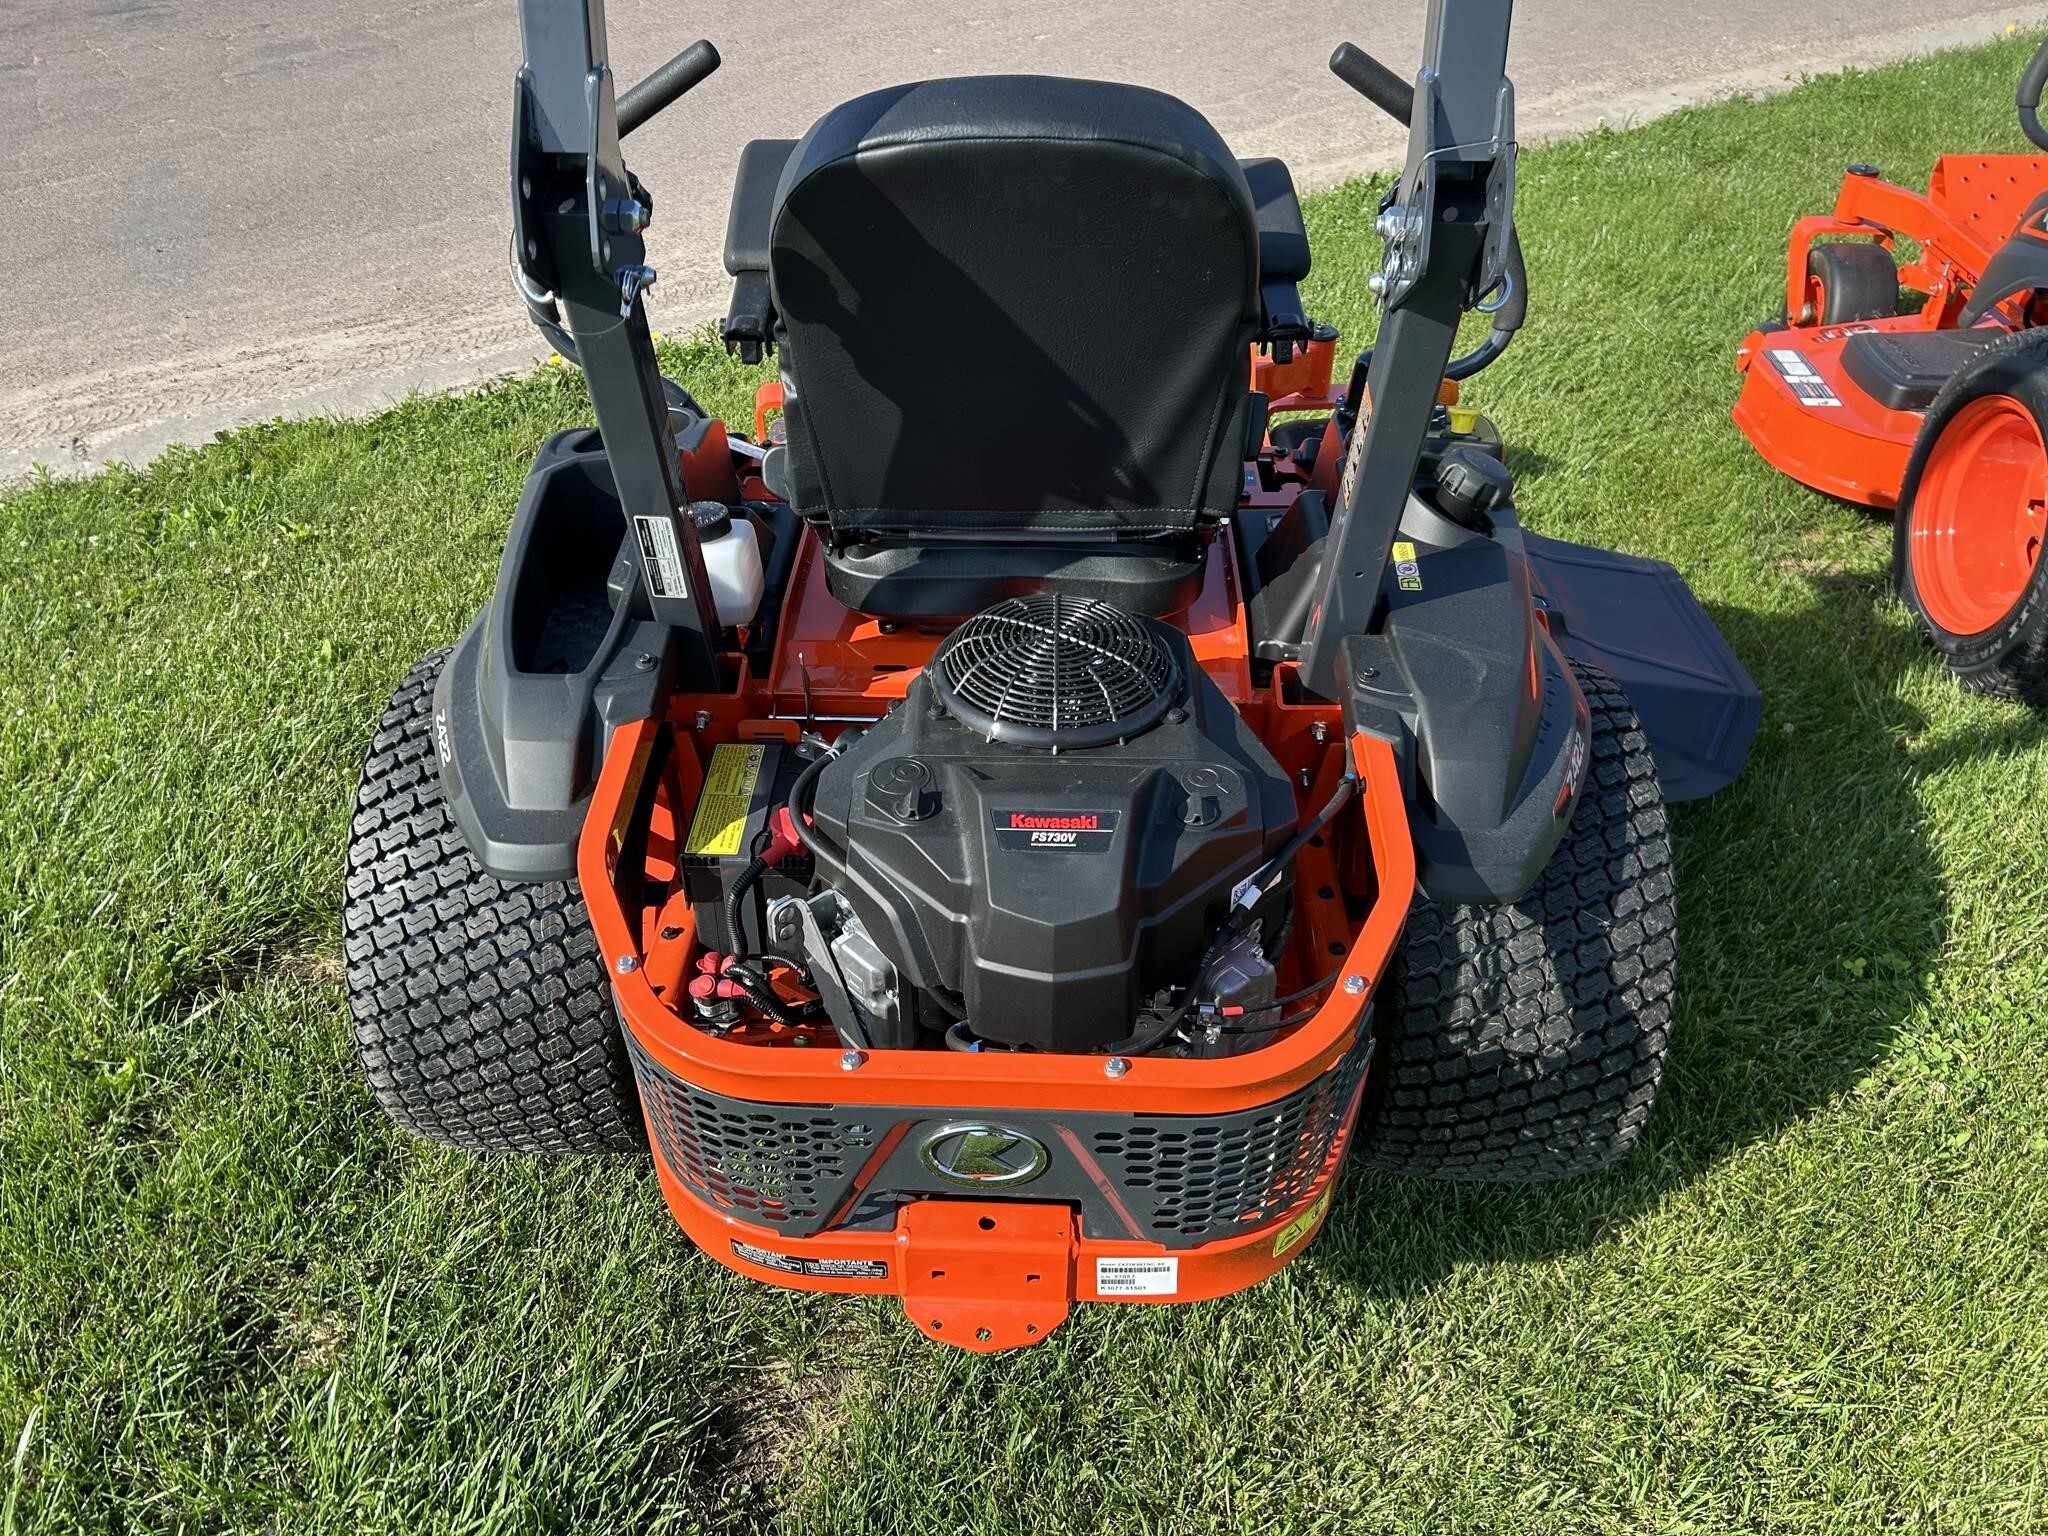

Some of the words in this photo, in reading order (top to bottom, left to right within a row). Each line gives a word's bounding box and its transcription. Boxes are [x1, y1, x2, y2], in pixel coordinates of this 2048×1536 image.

[436, 709, 451, 768] Z422
[1566, 731, 1585, 797] Z422
[1011, 814, 1097, 829] Kawasaki
[1031, 832, 1077, 842] FS730V
[742, 1242, 786, 1259] IMPORTANT
[819, 1258, 873, 1266] IMPORTANTE
